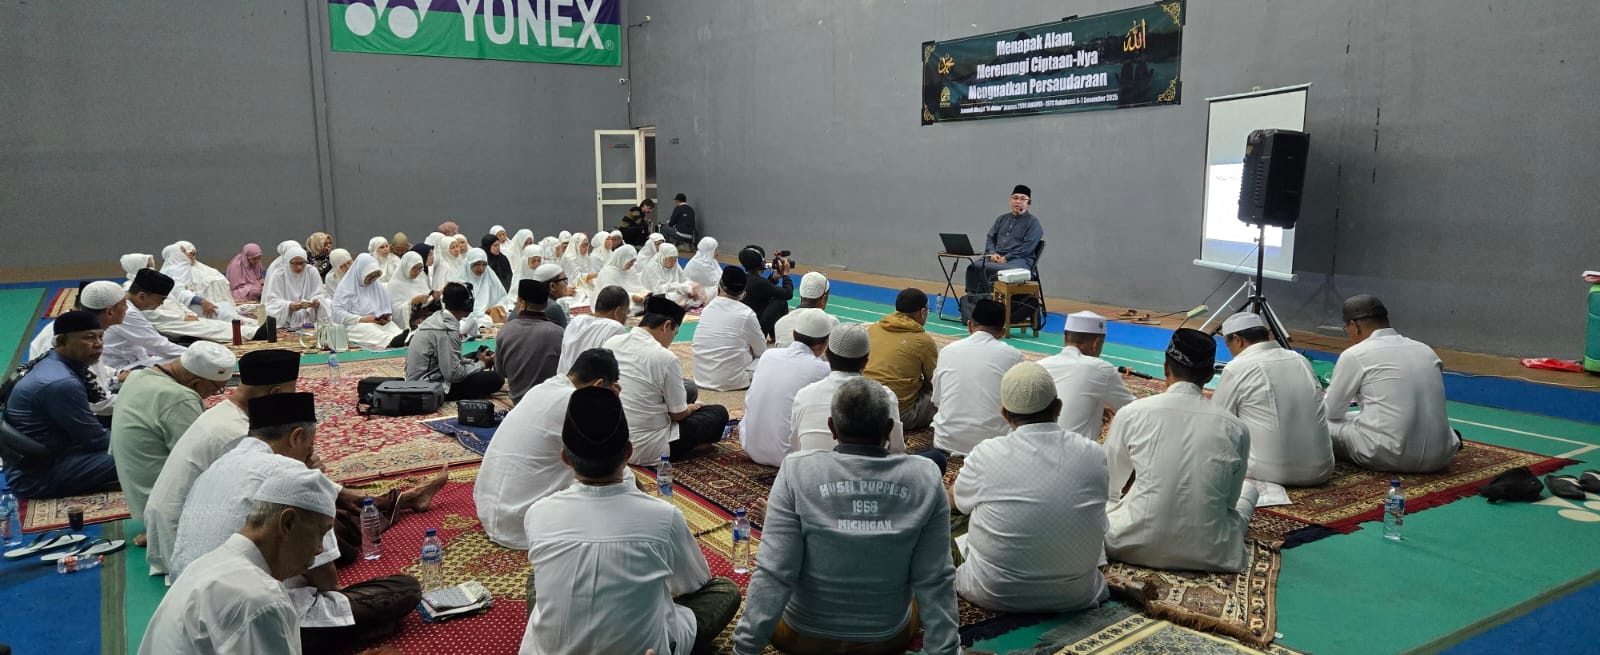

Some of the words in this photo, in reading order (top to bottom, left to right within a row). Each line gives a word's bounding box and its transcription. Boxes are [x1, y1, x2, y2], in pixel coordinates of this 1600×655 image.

[456, 0, 604, 49] YONEX
[996, 34, 1043, 56] Menapak
[1044, 31, 1075, 49] Alam,
[976, 58, 1029, 79] Merenungi
[1030, 49, 1099, 73] Ciptaan-Nya
[968, 81, 1028, 100] Menguatkan
[1029, 71, 1107, 94] Persaudaraan
[819, 480, 855, 497] HUSH
[852, 499, 878, 513] 1958
[838, 518, 892, 530] MICHIGAN
